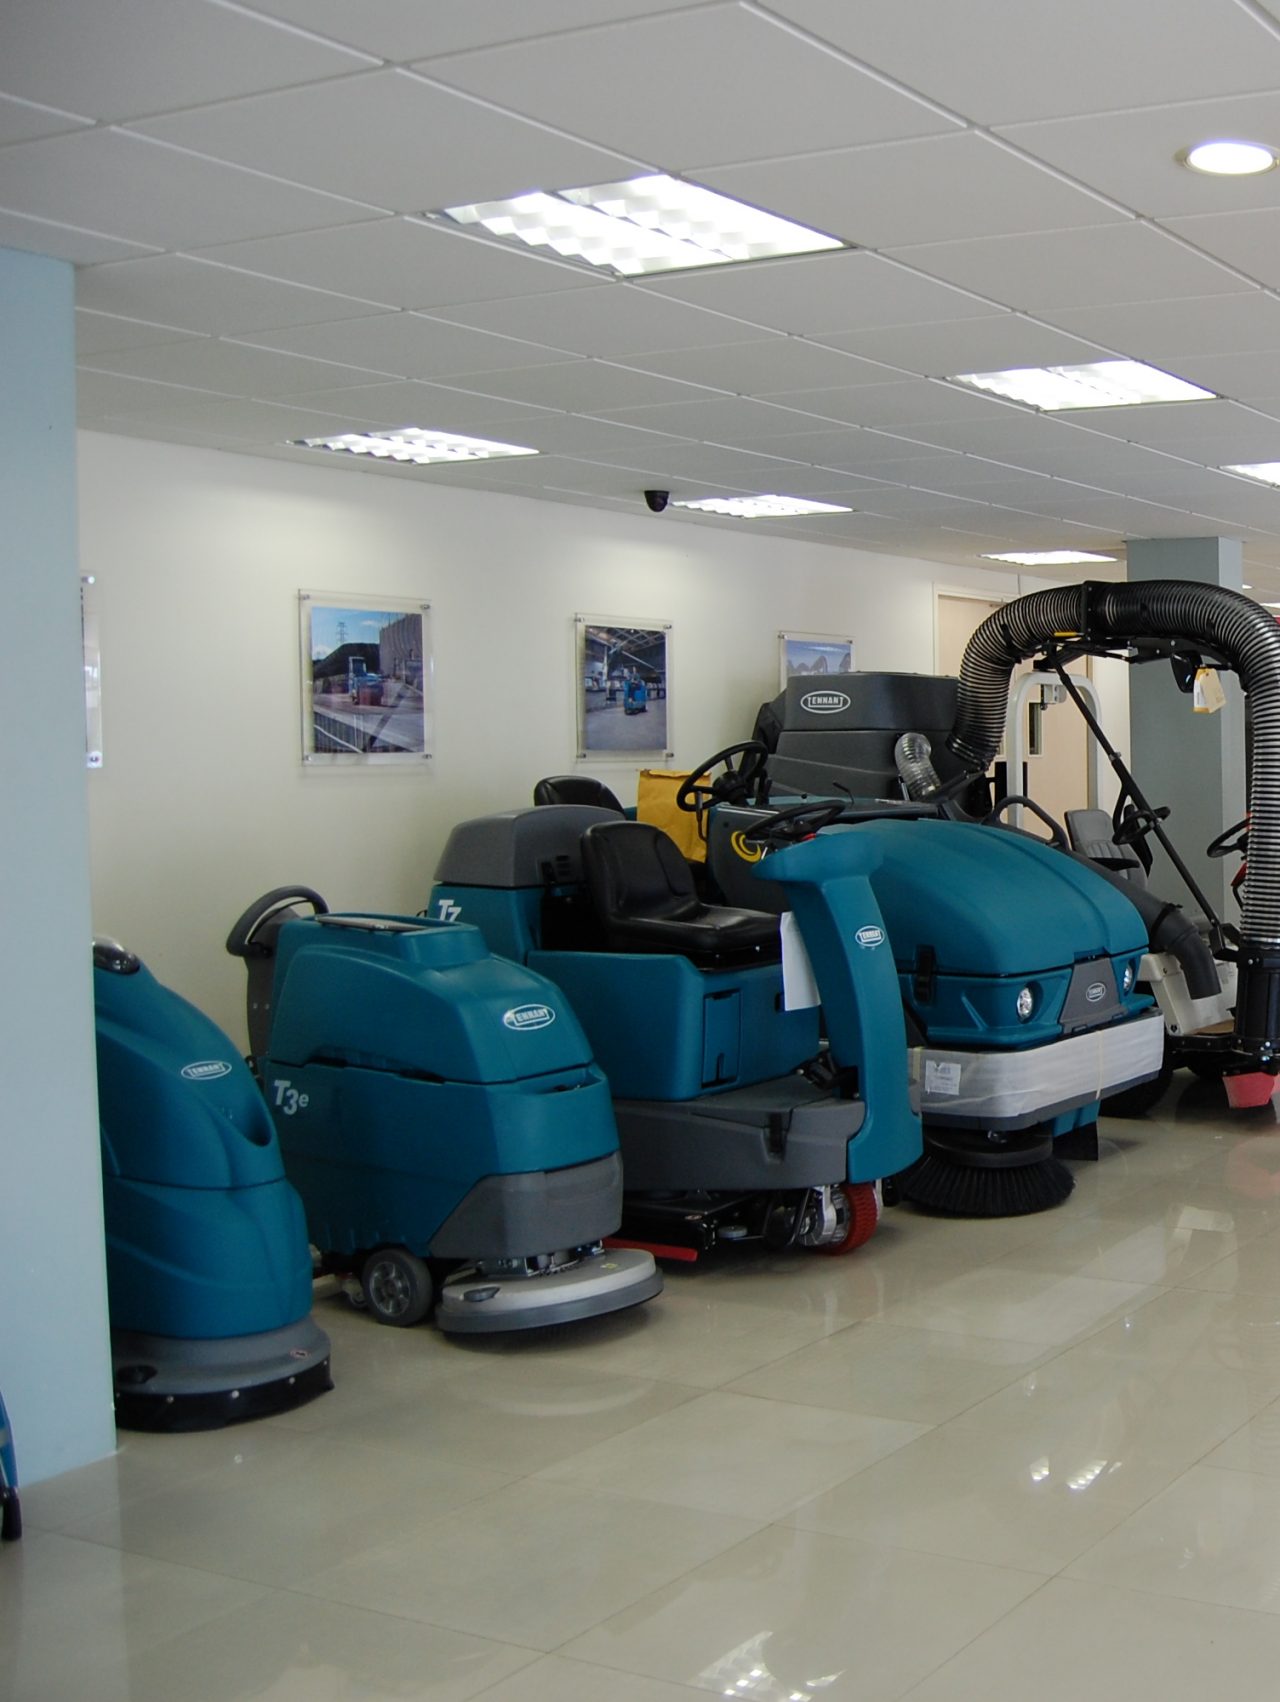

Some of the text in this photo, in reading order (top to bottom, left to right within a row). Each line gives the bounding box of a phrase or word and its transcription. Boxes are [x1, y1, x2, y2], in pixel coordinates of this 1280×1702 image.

[807, 696, 844, 708] TENNANT
[438, 899, 463, 923] T7
[273, 1079, 310, 1116] T3e
